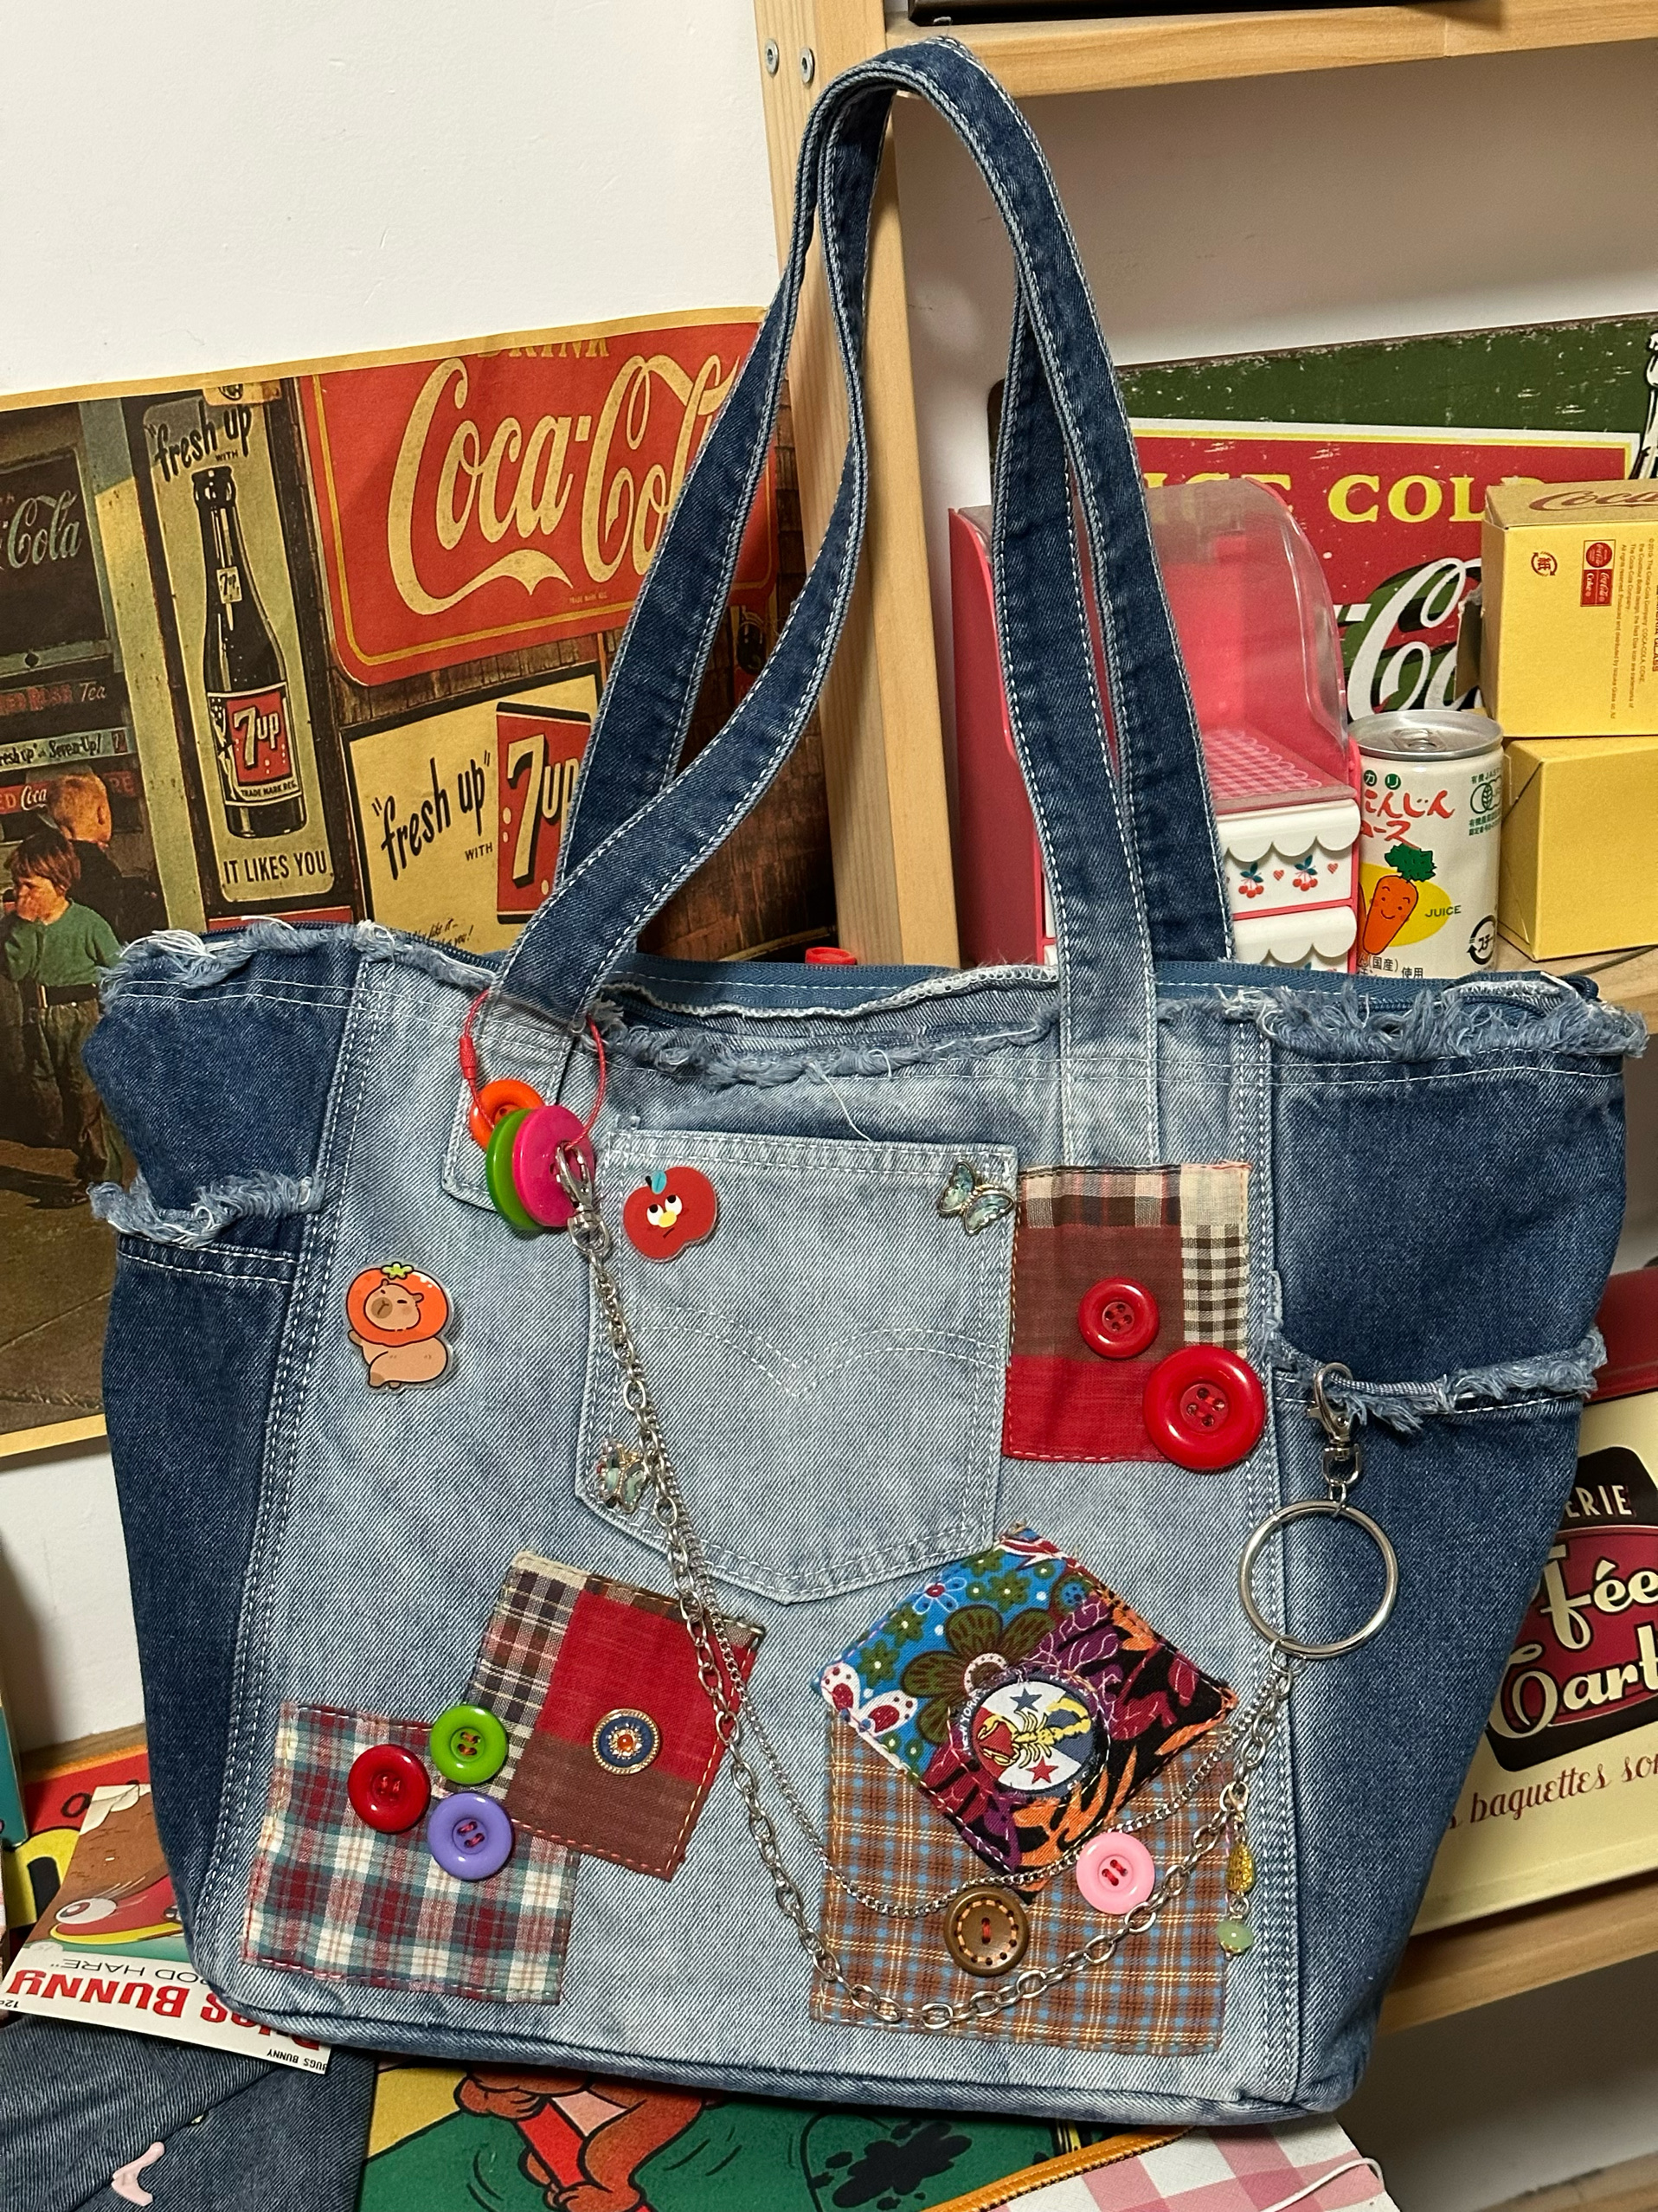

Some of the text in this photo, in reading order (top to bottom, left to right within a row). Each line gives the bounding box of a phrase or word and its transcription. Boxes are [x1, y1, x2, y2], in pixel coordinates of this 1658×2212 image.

[216, 449, 239, 462] WITH
[388, 354, 740, 615] Coca-Col
[1328, 474, 1546, 523] COL
[80, 681, 106, 702] Tea
[465, 842, 493, 862] WITH
[223, 850, 328, 884] IT LIKES YOU
[1424, 904, 1462, 918] JUICE
[1469, 1763, 1613, 1823] baguettes
[6, 1969, 190, 2018] BUNNY
[267, 2048, 299, 2064] BUNNY
